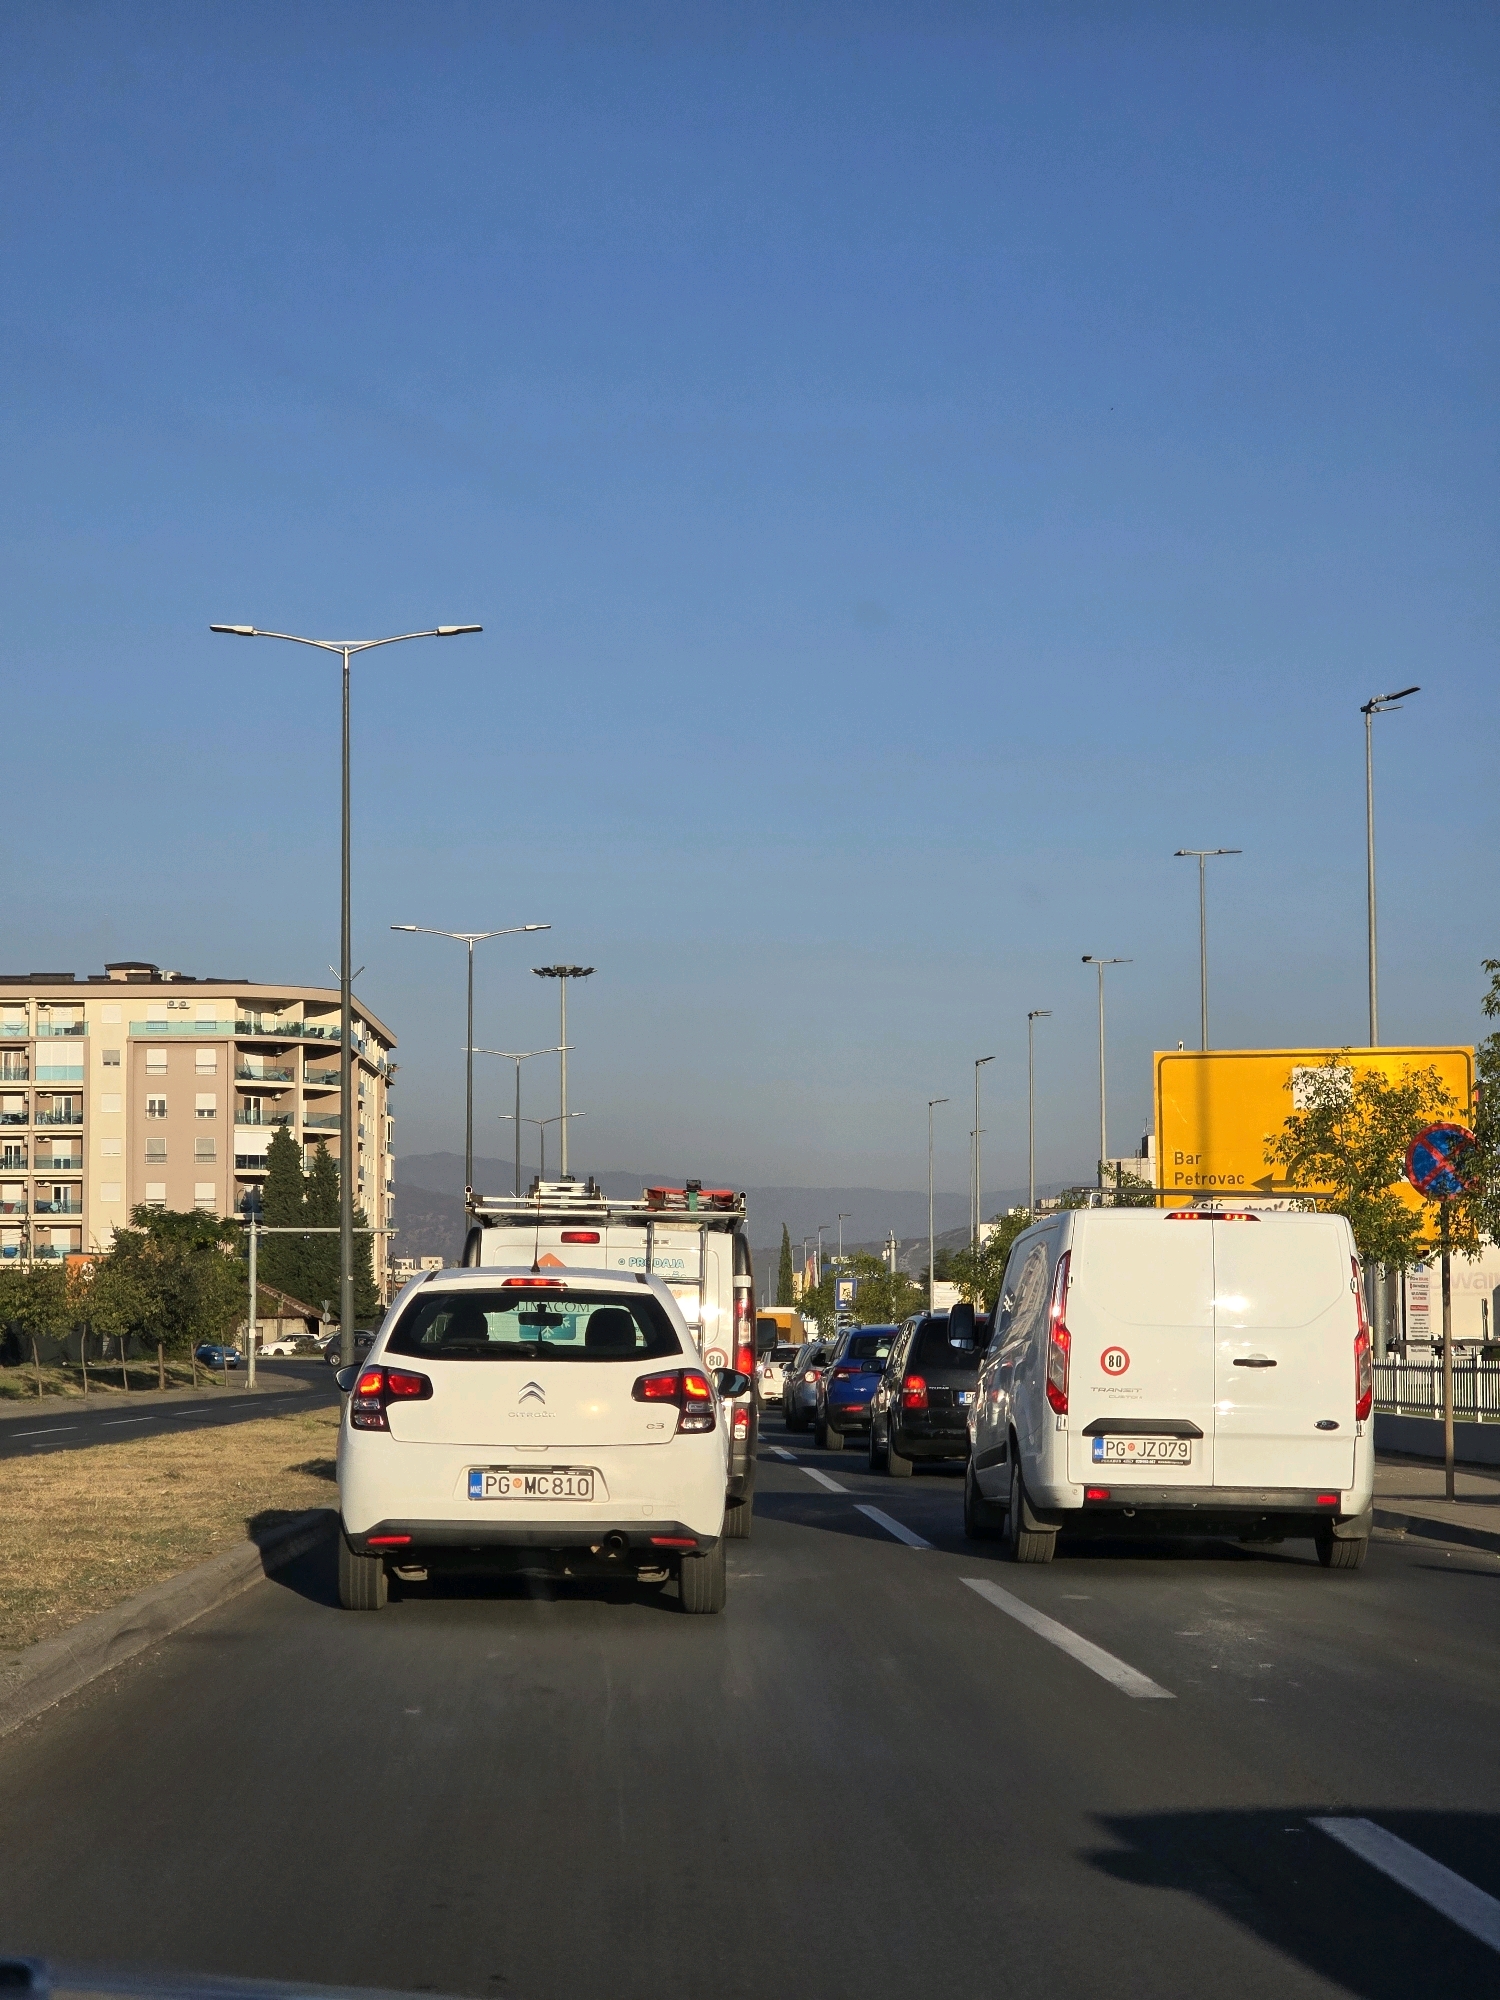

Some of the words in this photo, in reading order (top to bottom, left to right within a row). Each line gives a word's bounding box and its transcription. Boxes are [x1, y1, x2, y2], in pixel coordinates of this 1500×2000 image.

[1174, 1151, 1202, 1165] Bar
[1174, 1172, 1245, 1186] Petrovac
[708, 1355, 722, 1367] 80
[1108, 1355, 1122, 1368] 80
[1106, 1441, 1126, 1457] PG
[1137, 1442, 1188, 1458] JZ079
[470, 1485, 482, 1494] MNE
[485, 1476, 510, 1495] PG
[524, 1476, 590, 1496] MC810
